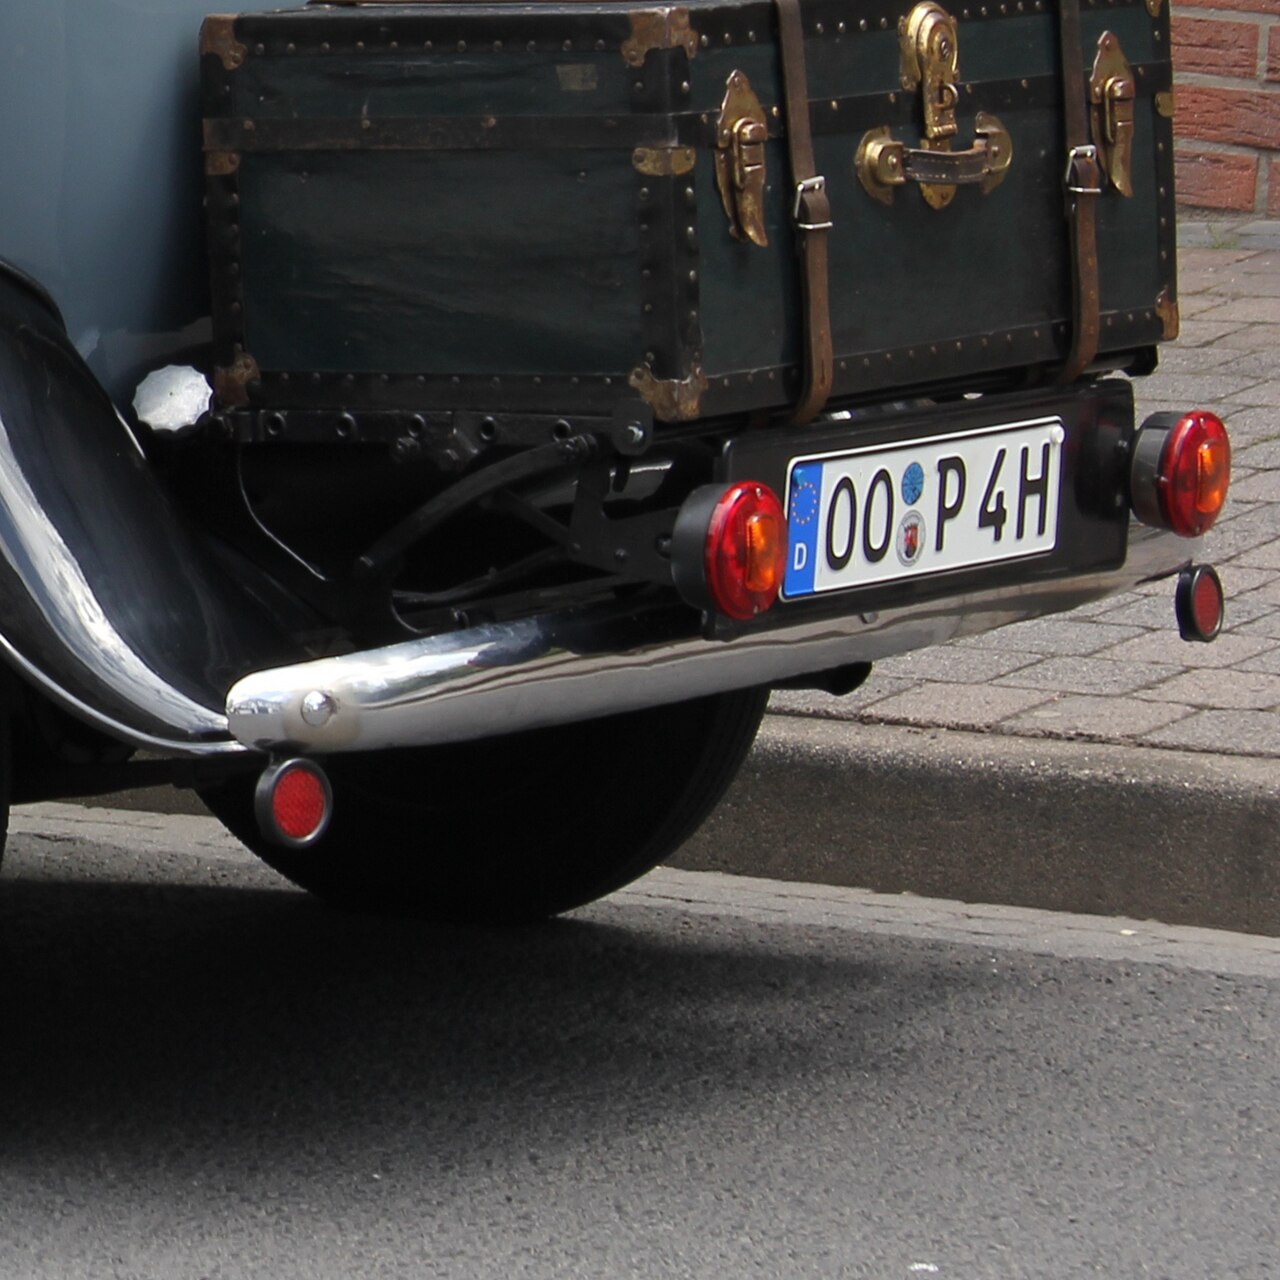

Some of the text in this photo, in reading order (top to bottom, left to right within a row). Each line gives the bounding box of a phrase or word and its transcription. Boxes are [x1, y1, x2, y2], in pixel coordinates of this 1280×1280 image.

[793, 543, 809, 570] D
[936, 456, 967, 552] P
[978, 442, 1051, 543] 4H
